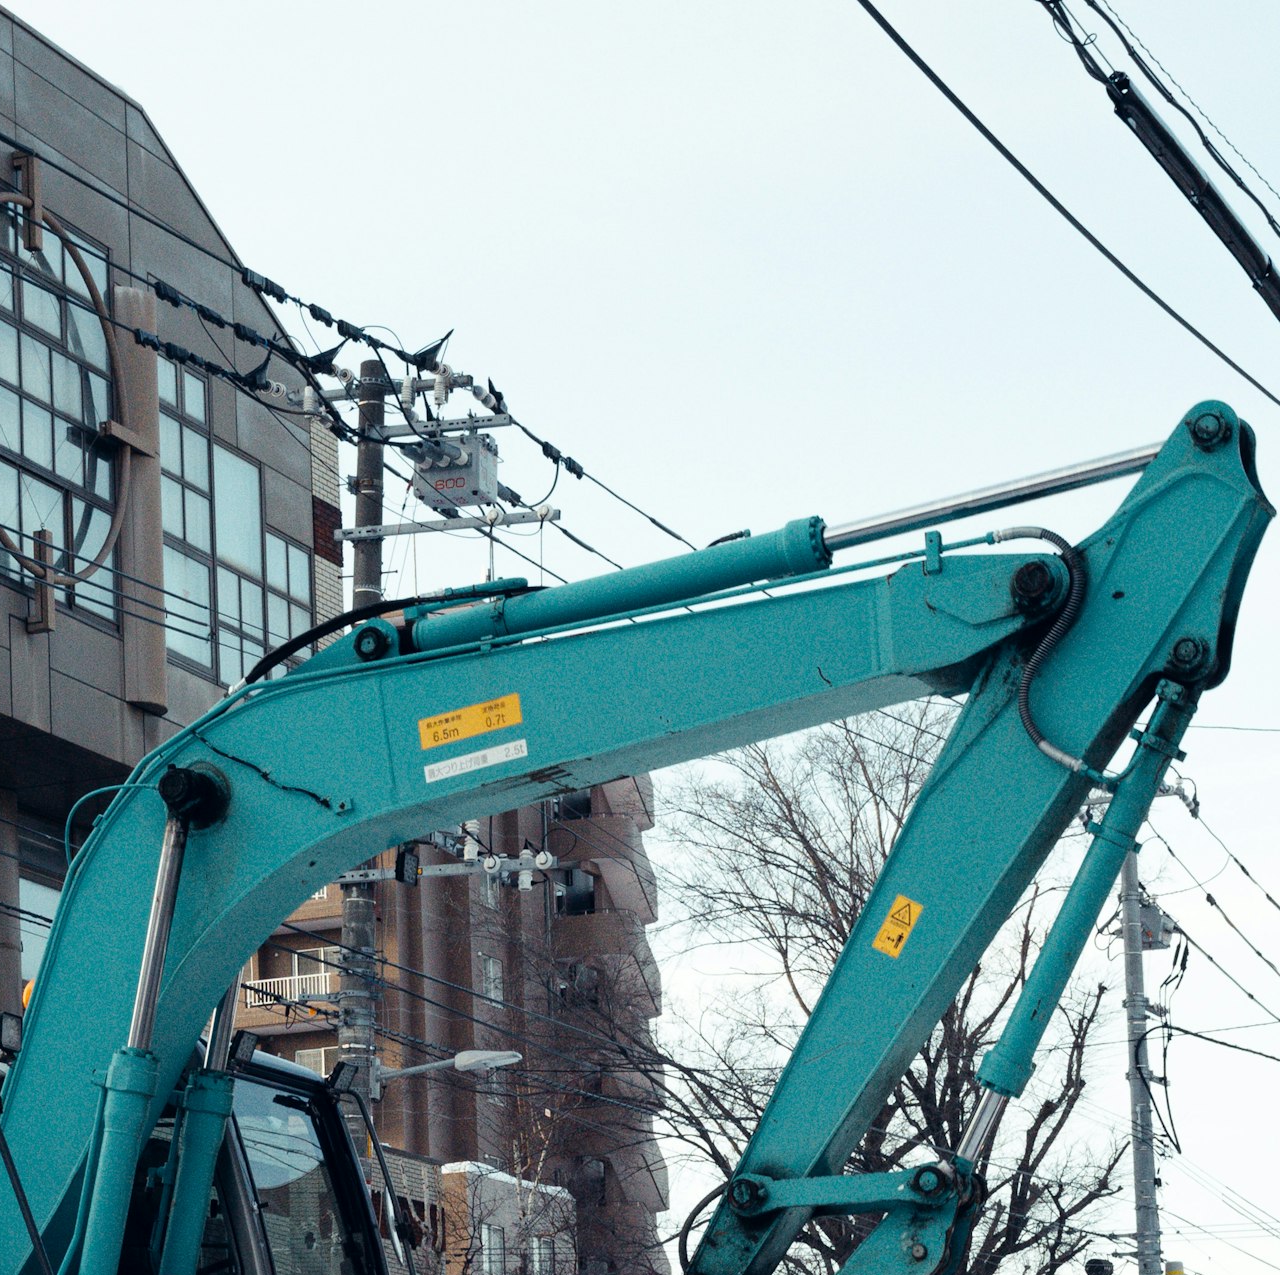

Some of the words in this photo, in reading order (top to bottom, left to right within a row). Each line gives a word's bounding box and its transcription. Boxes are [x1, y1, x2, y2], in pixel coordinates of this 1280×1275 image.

[432, 727, 459, 742] 6.5m
[485, 713, 506, 728] 0.7t
[504, 744, 525, 758] 2.5t
